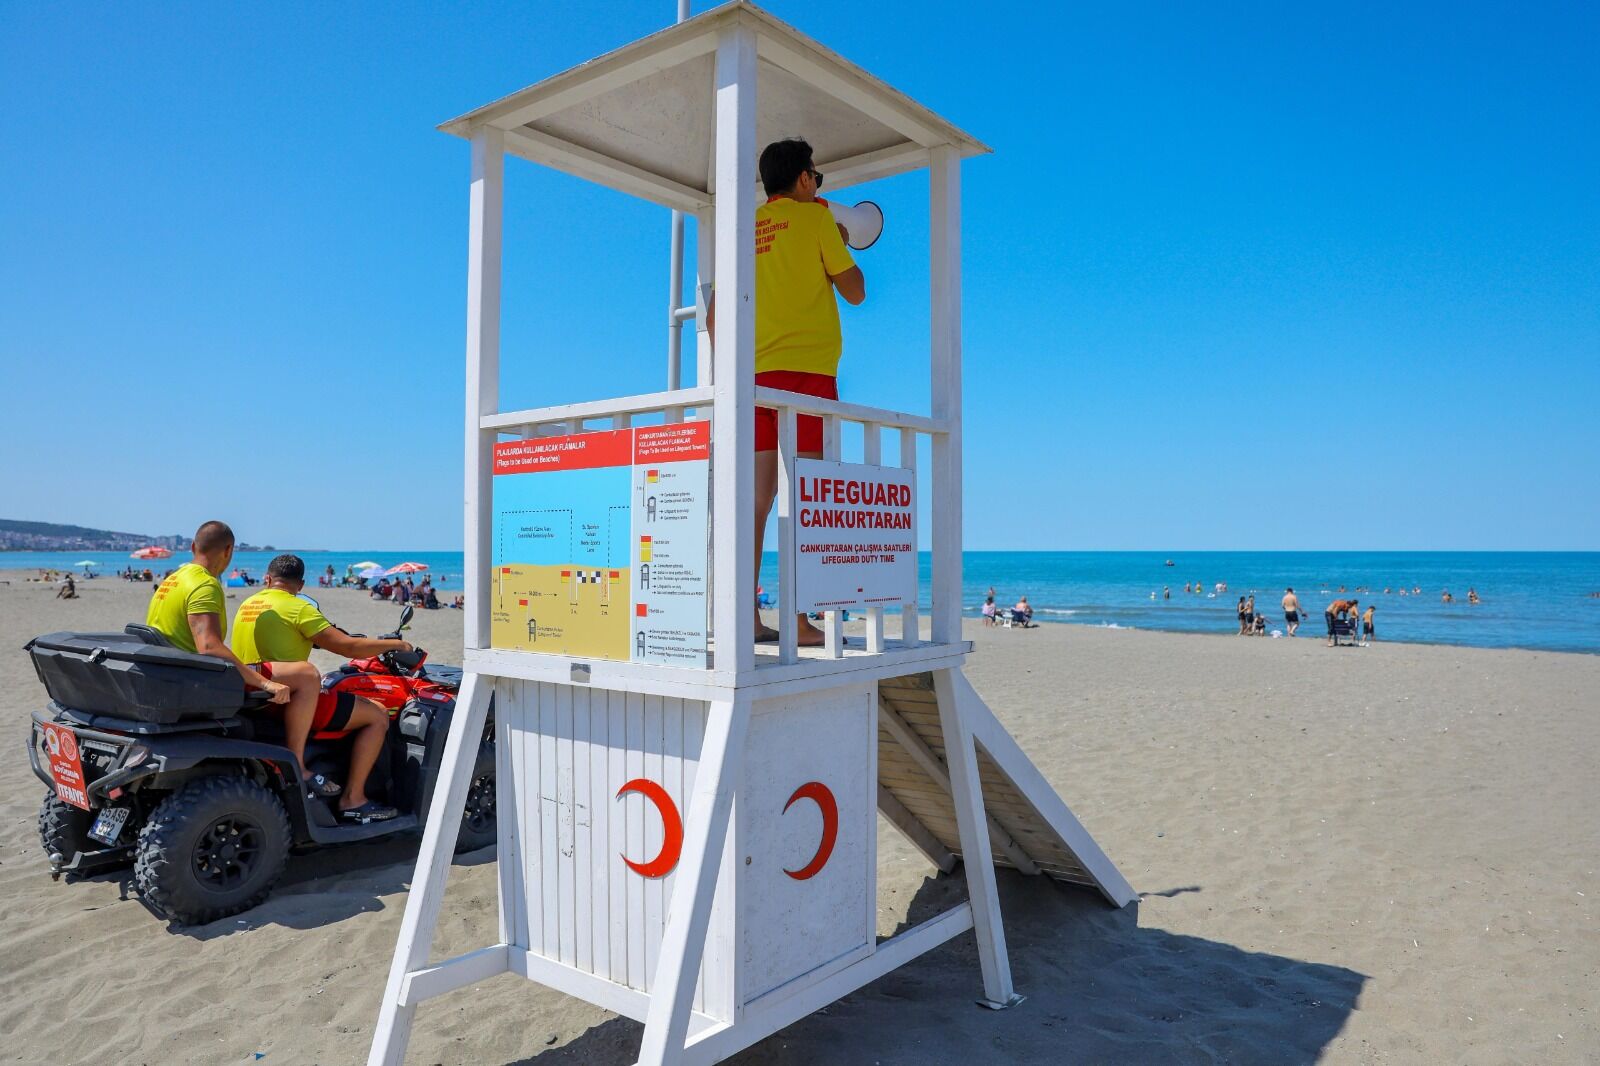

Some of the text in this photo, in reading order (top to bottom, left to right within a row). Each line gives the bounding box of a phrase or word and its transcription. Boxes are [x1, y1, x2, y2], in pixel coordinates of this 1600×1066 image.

[669, 437, 691, 445] FLAMALAR
[497, 441, 586, 457] PLAJLARDA KULLANILACAK FLAMALAR
[800, 477, 911, 507] LIFEGUARD
[800, 508, 911, 529] CANKURTARAN
[800, 542, 912, 555] CANKURTARAN ÇALIŞMA SAATLERİ
[822, 554, 895, 564] LIFEGUARD DUTY TIME
[111, 809, 127, 823] ASB
